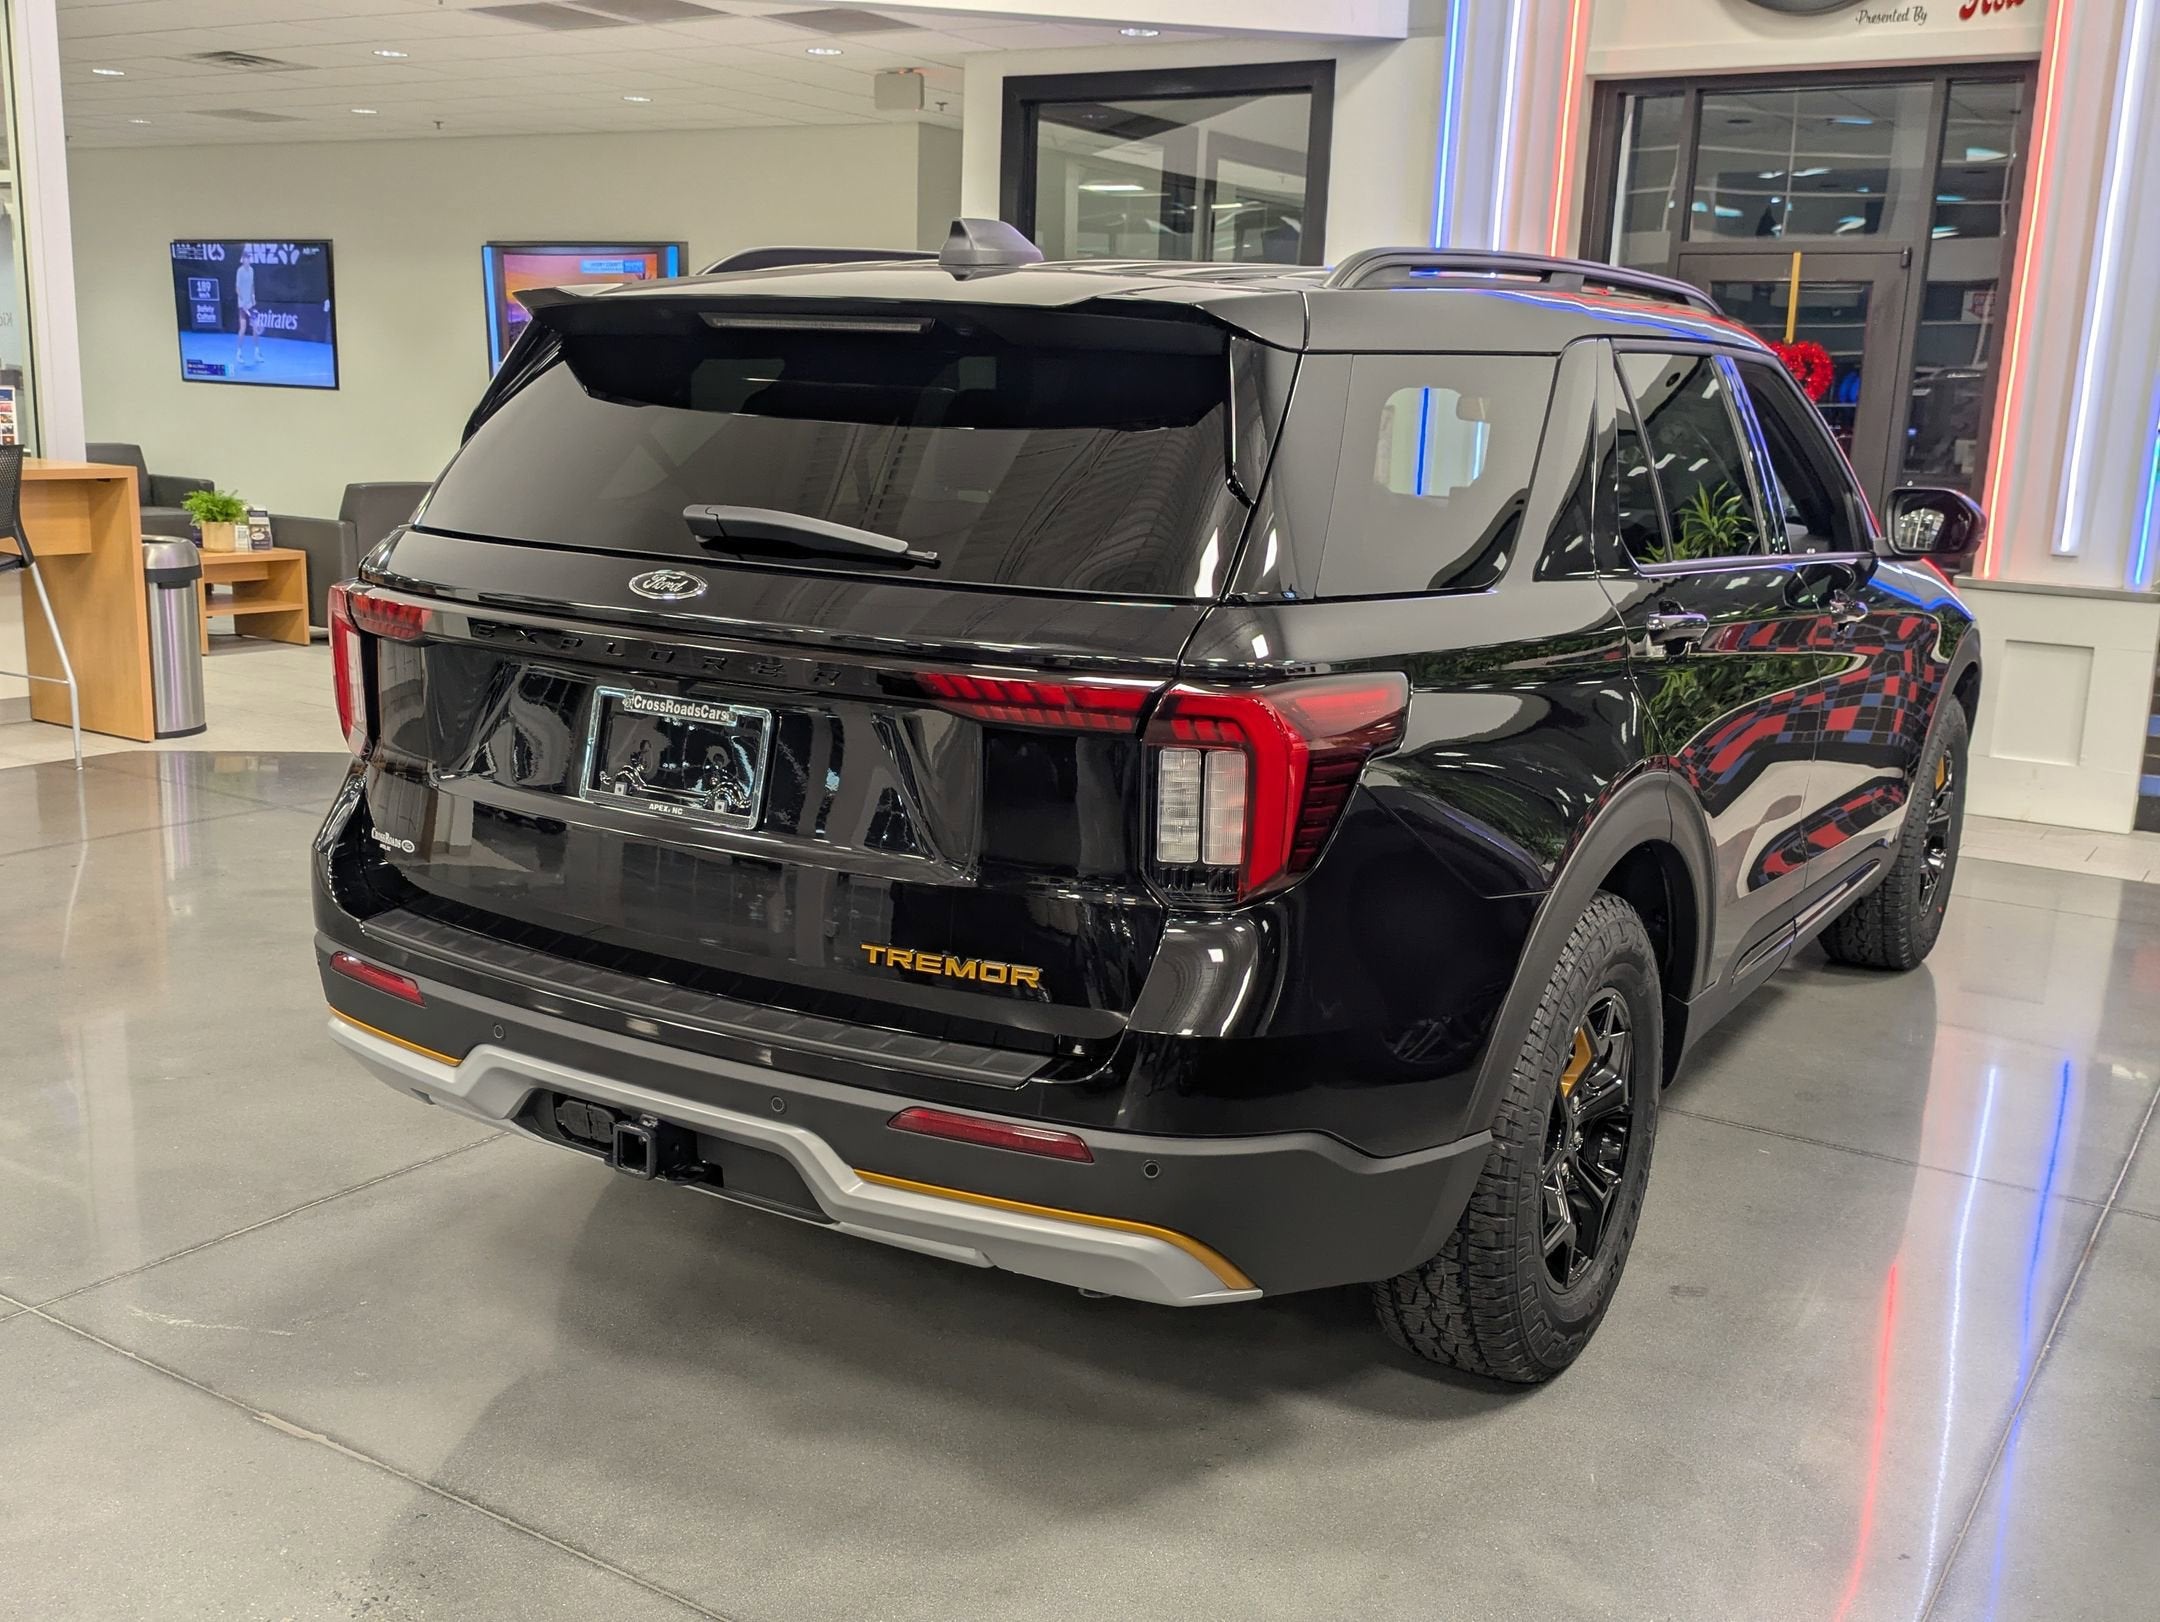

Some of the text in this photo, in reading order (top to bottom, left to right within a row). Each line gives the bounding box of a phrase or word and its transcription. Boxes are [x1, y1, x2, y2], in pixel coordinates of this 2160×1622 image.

[1858, 6, 1928, 26] Presented By
[642, 574, 689, 592] Ford
[471, 623, 842, 687] EXPLORER
[671, 806, 684, 815] NC
[861, 942, 1041, 989] TREMOR
